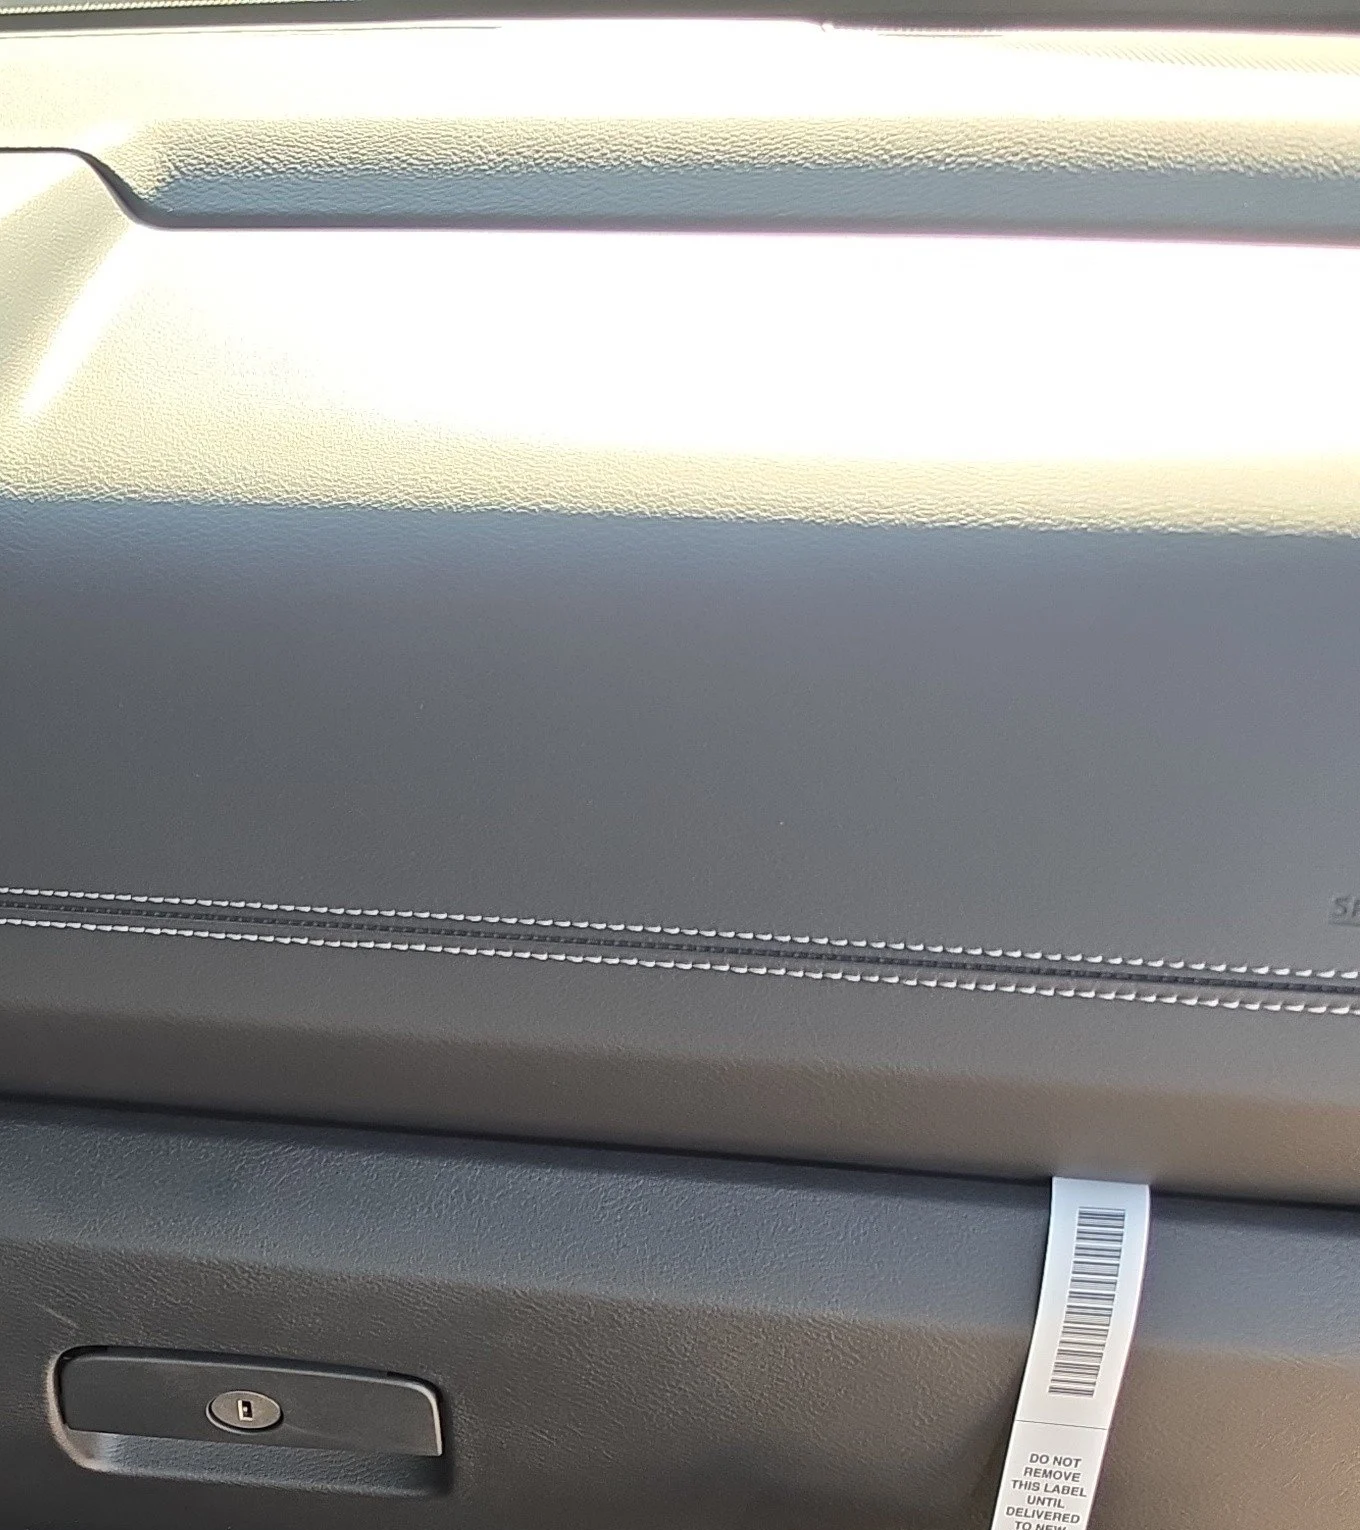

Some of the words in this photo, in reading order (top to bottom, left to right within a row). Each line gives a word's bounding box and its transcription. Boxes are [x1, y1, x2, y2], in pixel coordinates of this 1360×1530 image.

[1029, 1453, 1049, 1464] DO
[1052, 1455, 1082, 1468] NOT
[1023, 1466, 1081, 1482] REMOVE
[1011, 1479, 1040, 1491] THIS
[1043, 1482, 1087, 1497] LABEL
[1027, 1495, 1065, 1509] UNTIL
[1005, 1506, 1080, 1524] DELIVERED
